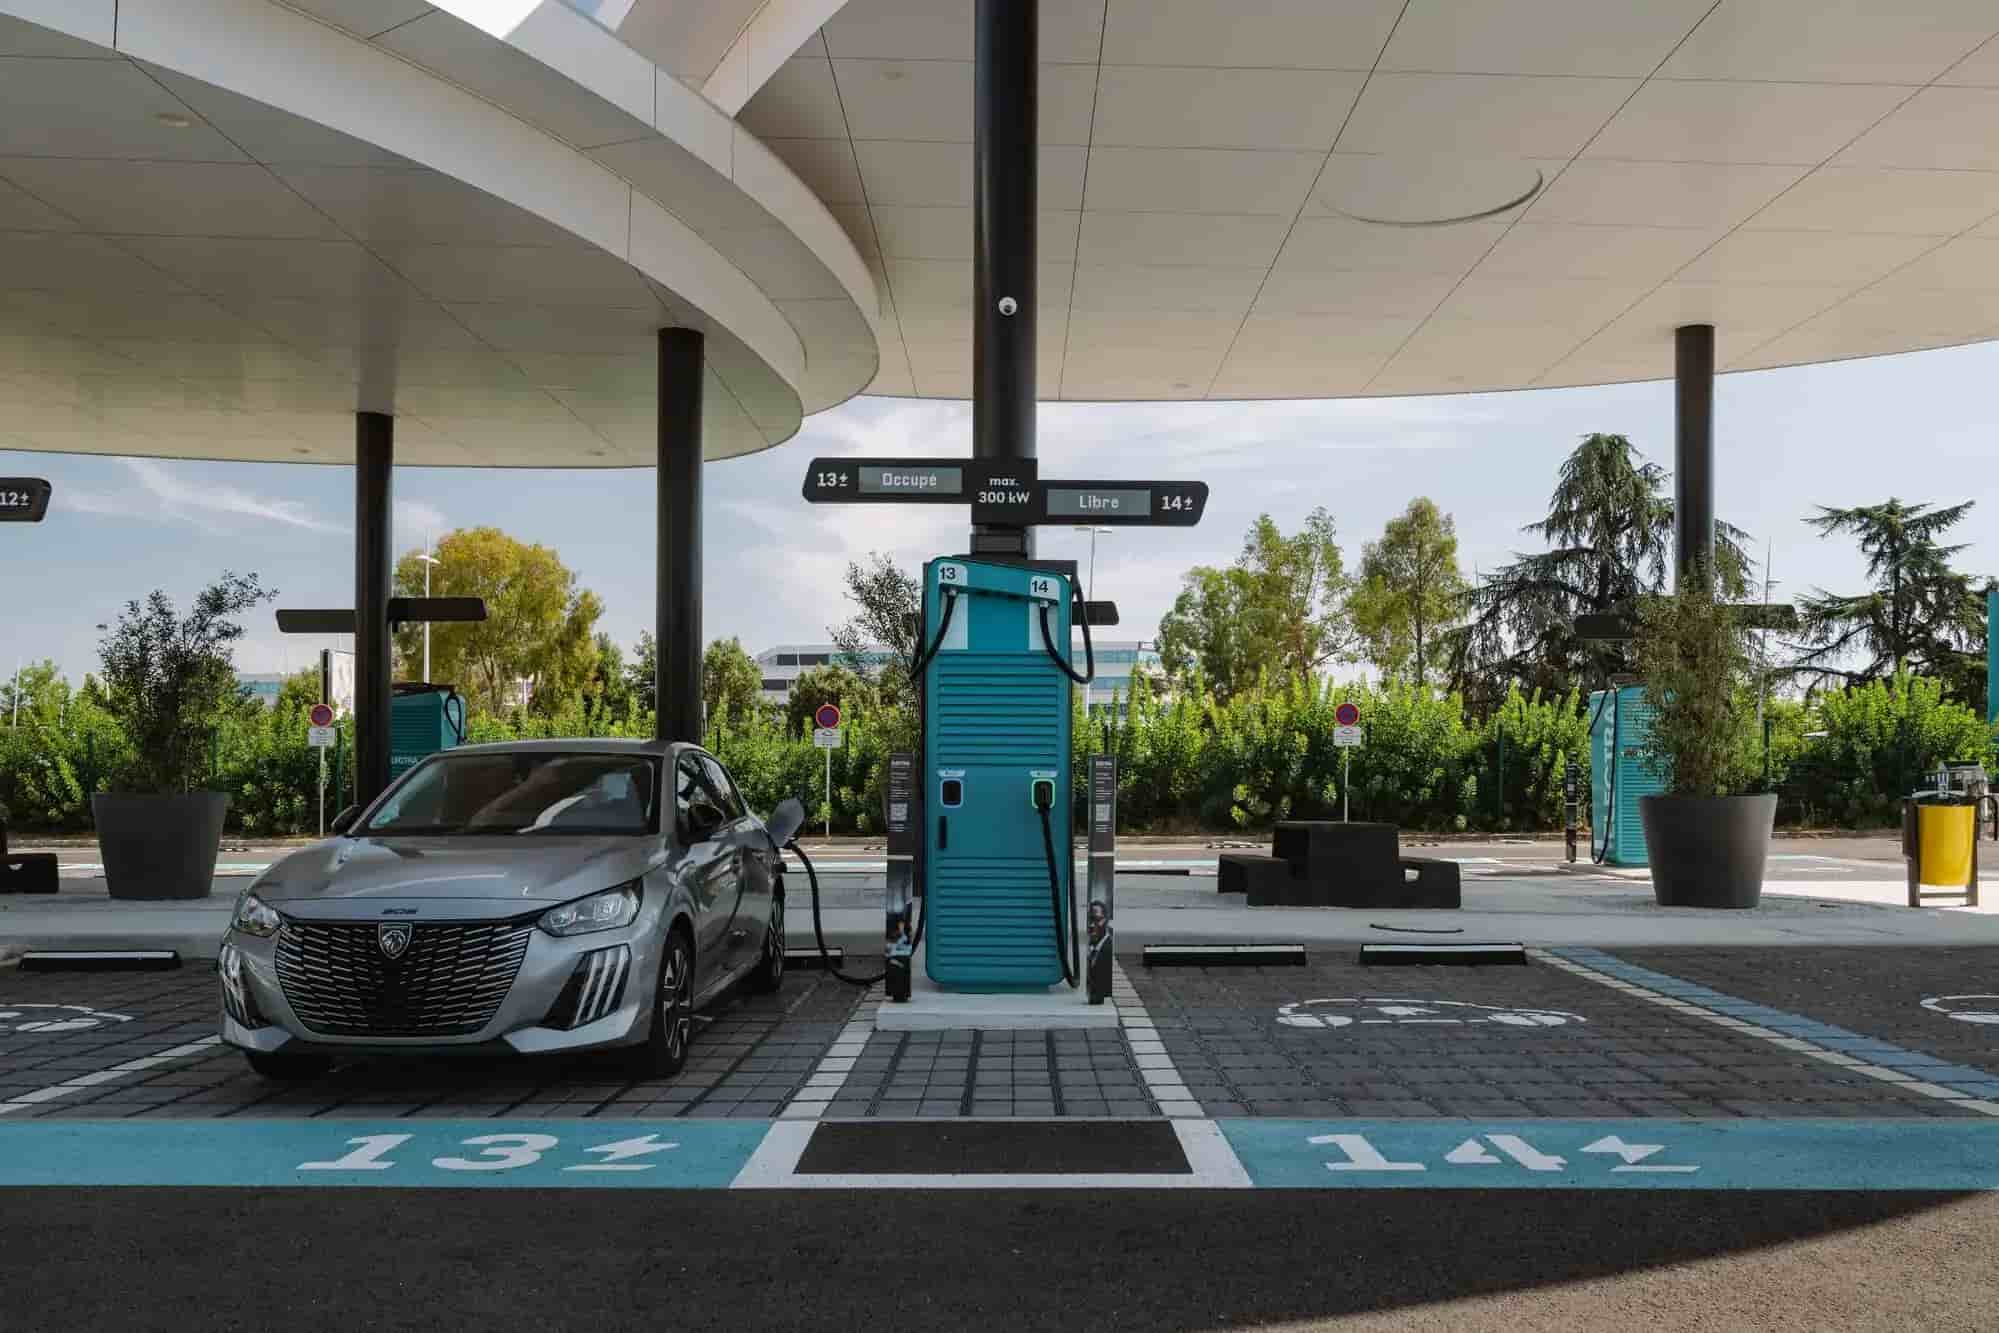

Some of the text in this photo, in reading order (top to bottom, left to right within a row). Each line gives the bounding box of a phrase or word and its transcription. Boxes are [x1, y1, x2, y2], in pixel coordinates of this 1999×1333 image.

[817, 473, 837, 487] 13
[882, 473, 937, 488] Occupé
[989, 477, 1019, 487] max.
[978, 491, 1030, 503] 300 kW
[1079, 495, 1119, 508] Libre
[1161, 496, 1181, 510] 14
[940, 567, 956, 580] 13
[1031, 580, 1048, 593] 14
